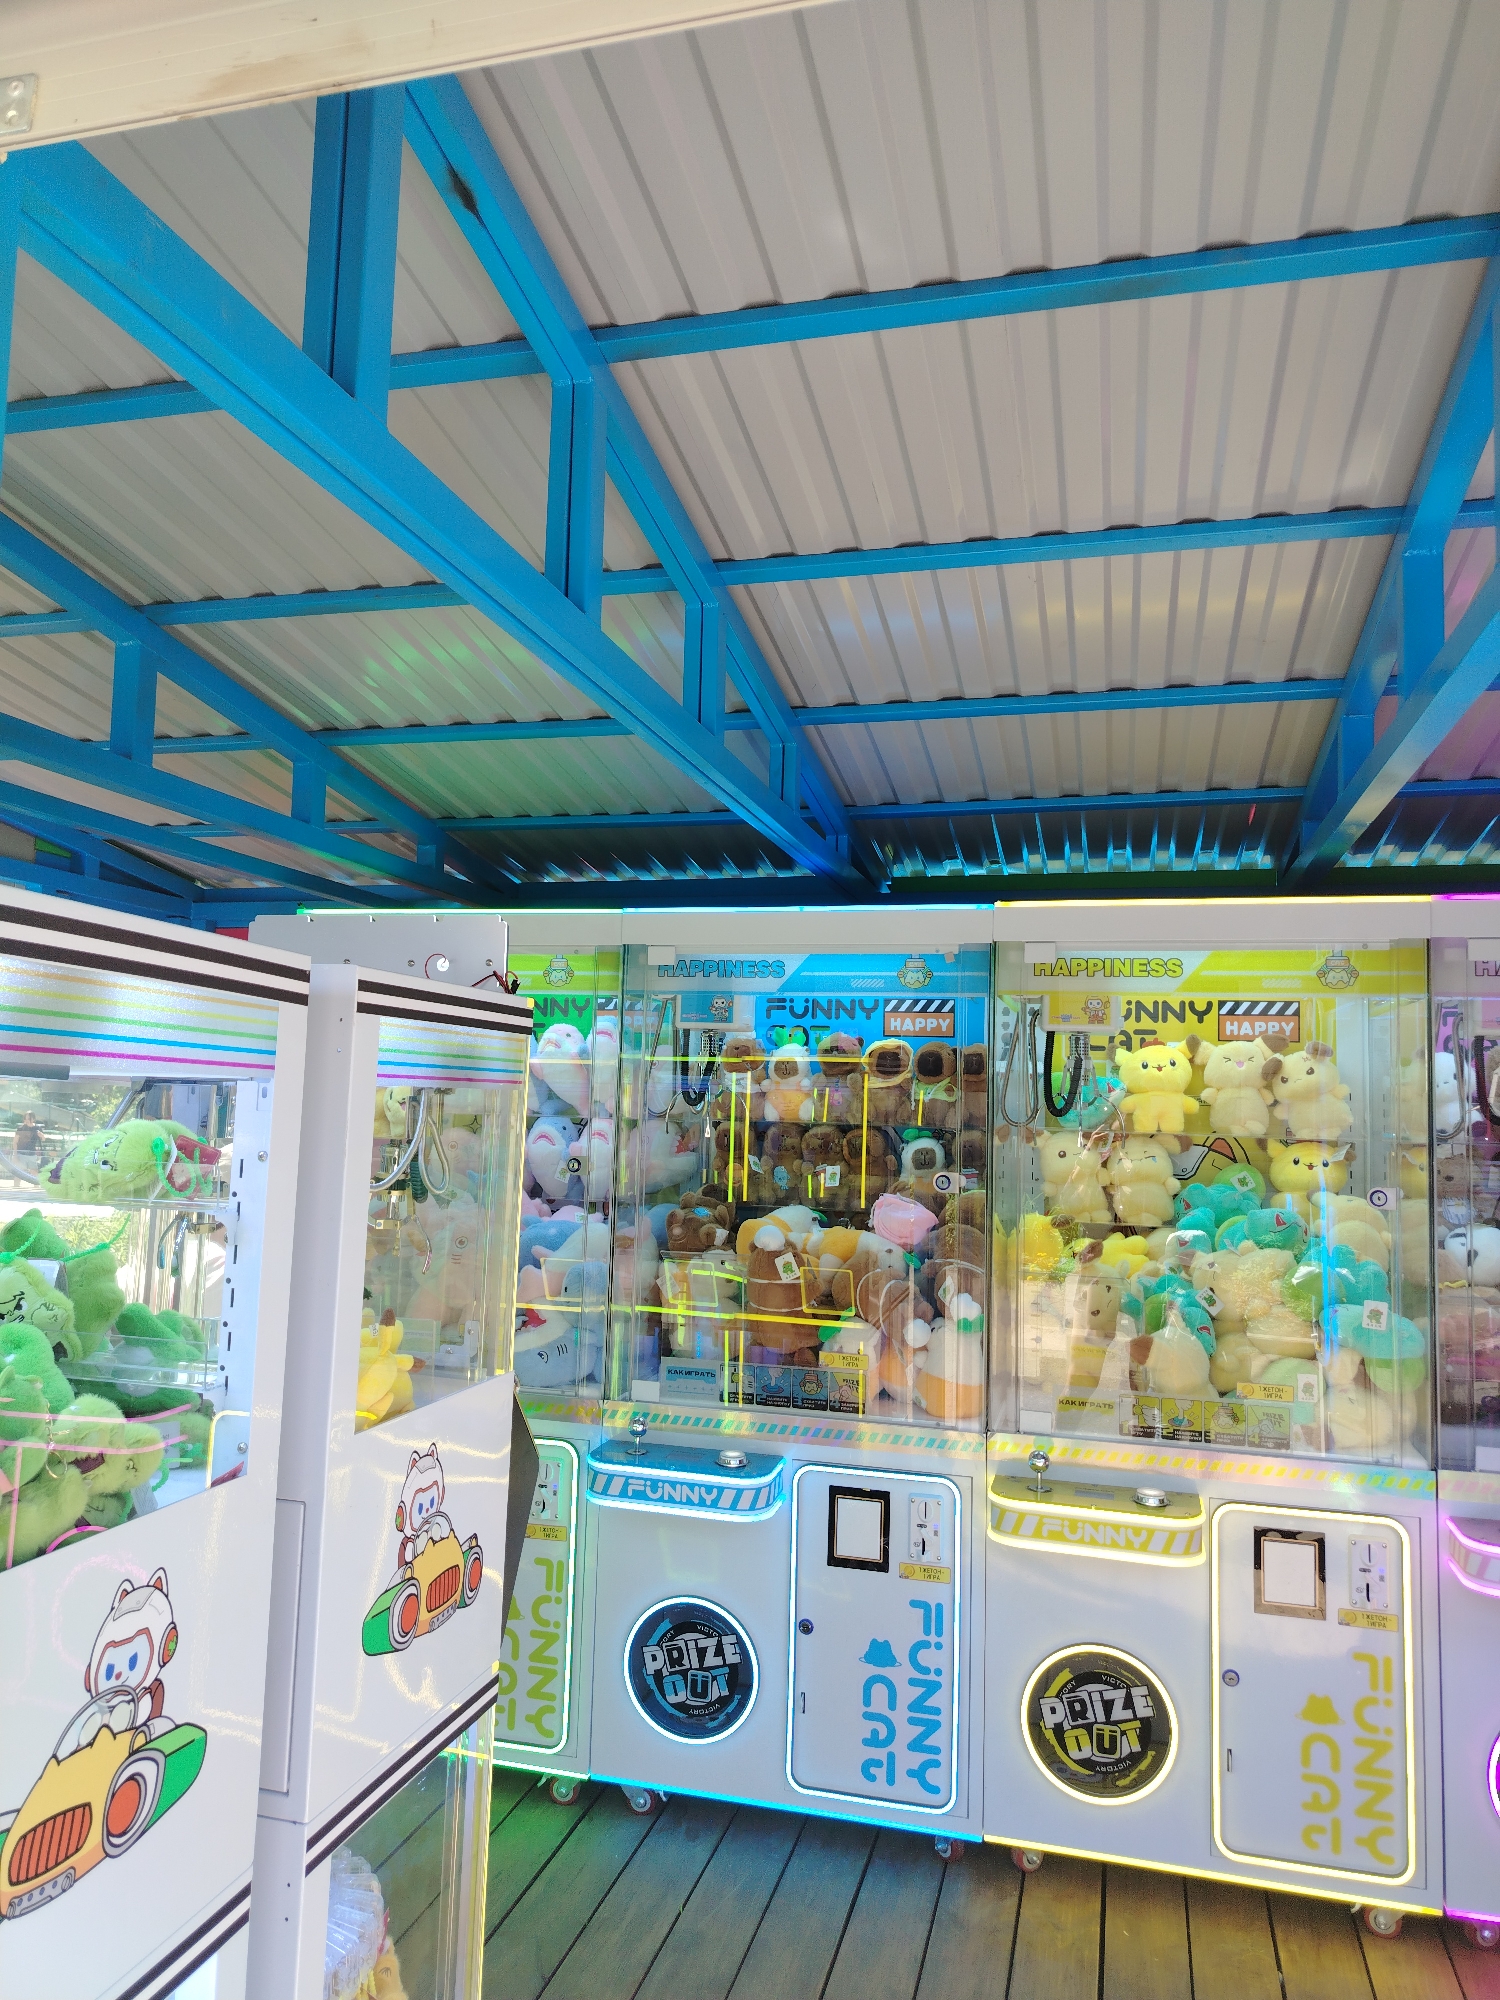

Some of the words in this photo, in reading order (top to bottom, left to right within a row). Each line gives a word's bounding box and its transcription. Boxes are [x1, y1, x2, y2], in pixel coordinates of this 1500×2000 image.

[658, 959, 786, 979] HAPPINESS
[1033, 957, 1184, 978] HAPPINESS
[533, 997, 591, 1018] NNY
[1122, 999, 1214, 1024] NNY
[890, 1017, 951, 1032] HAPPY
[1225, 1020, 1295, 1036] HAPPY
[1262, 1386, 1284, 1394] ЖЕТОН
[1365, 1614, 1388, 1622] ЖЕТОН
[696, 1624, 719, 1638] VICTO
[642, 1634, 742, 1677] PRIZE
[663, 1667, 730, 1704] OUT
[1101, 1674, 1127, 1689] VICTO
[688, 1703, 721, 1715] VICTORY
[1039, 1685, 1155, 1730] PRIZE
[860, 1673, 897, 1786] CAT
[1063, 1719, 1142, 1760] OUT
[1095, 1760, 1132, 1772] VICTORY
[1301, 1731, 1342, 1856] CAT
